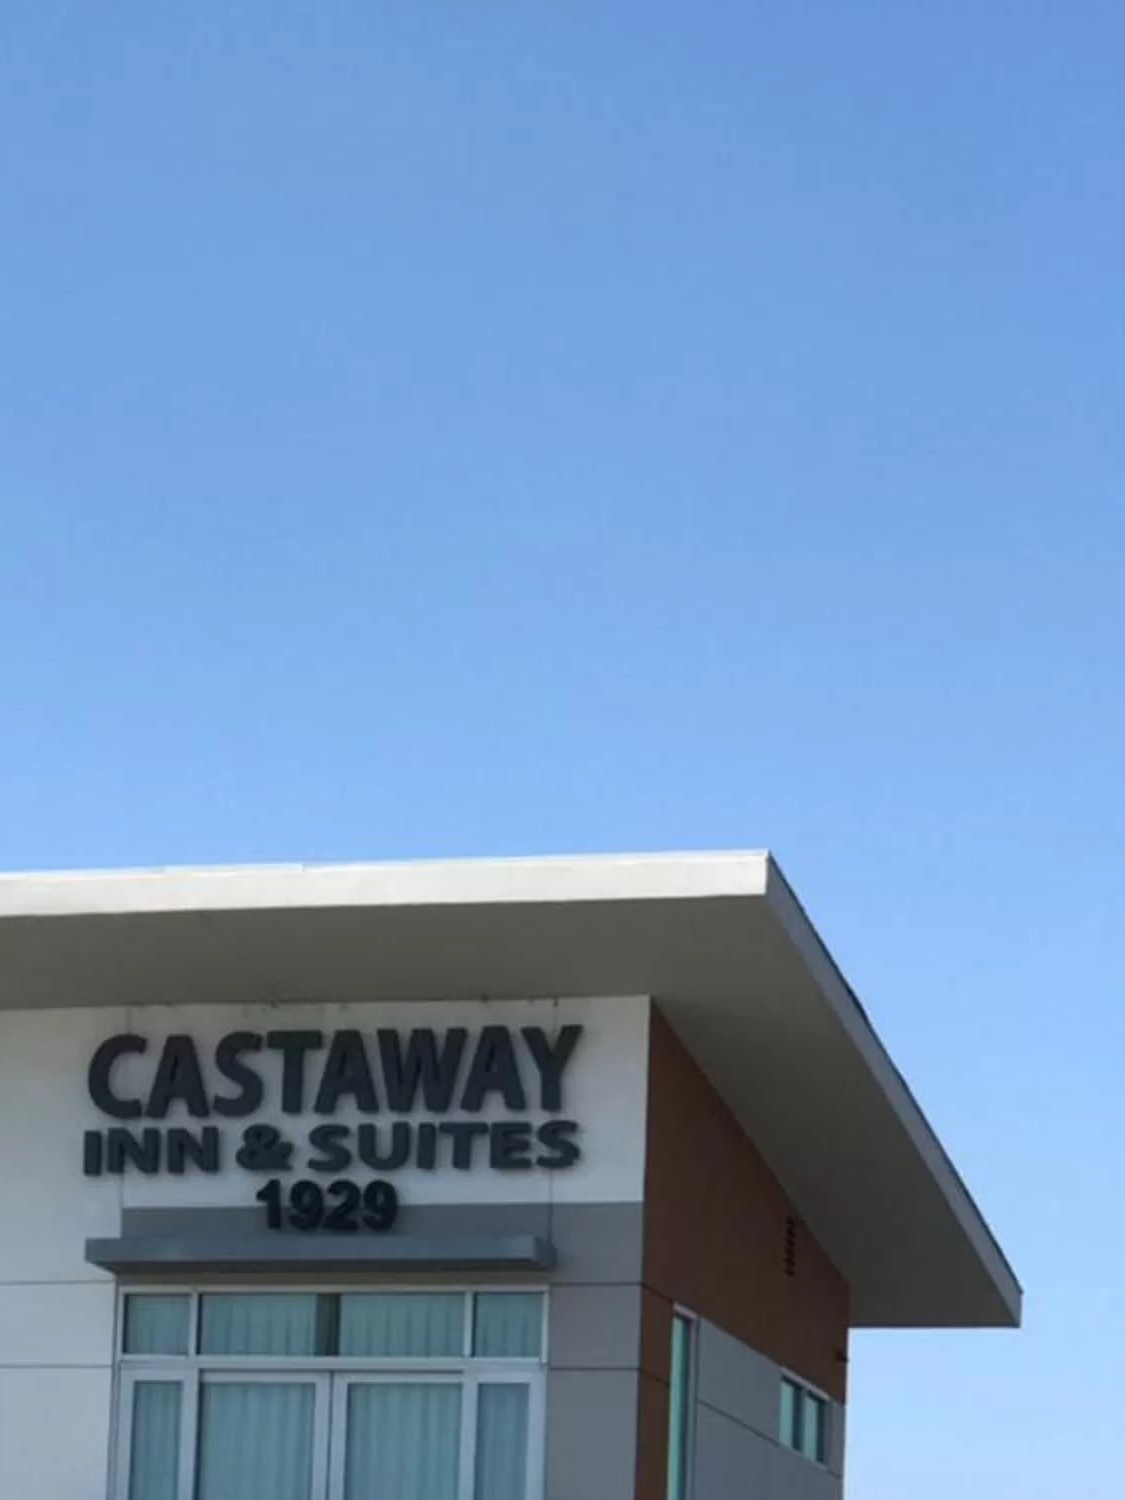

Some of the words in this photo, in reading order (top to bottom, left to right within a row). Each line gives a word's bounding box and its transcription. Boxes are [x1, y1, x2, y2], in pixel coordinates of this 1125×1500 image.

[87, 1025, 583, 1119] CASTAWAY
[83, 1126, 219, 1176] INN
[235, 1124, 293, 1171] &
[306, 1119, 581, 1172] SUITES
[256, 1179, 399, 1231] 1929
